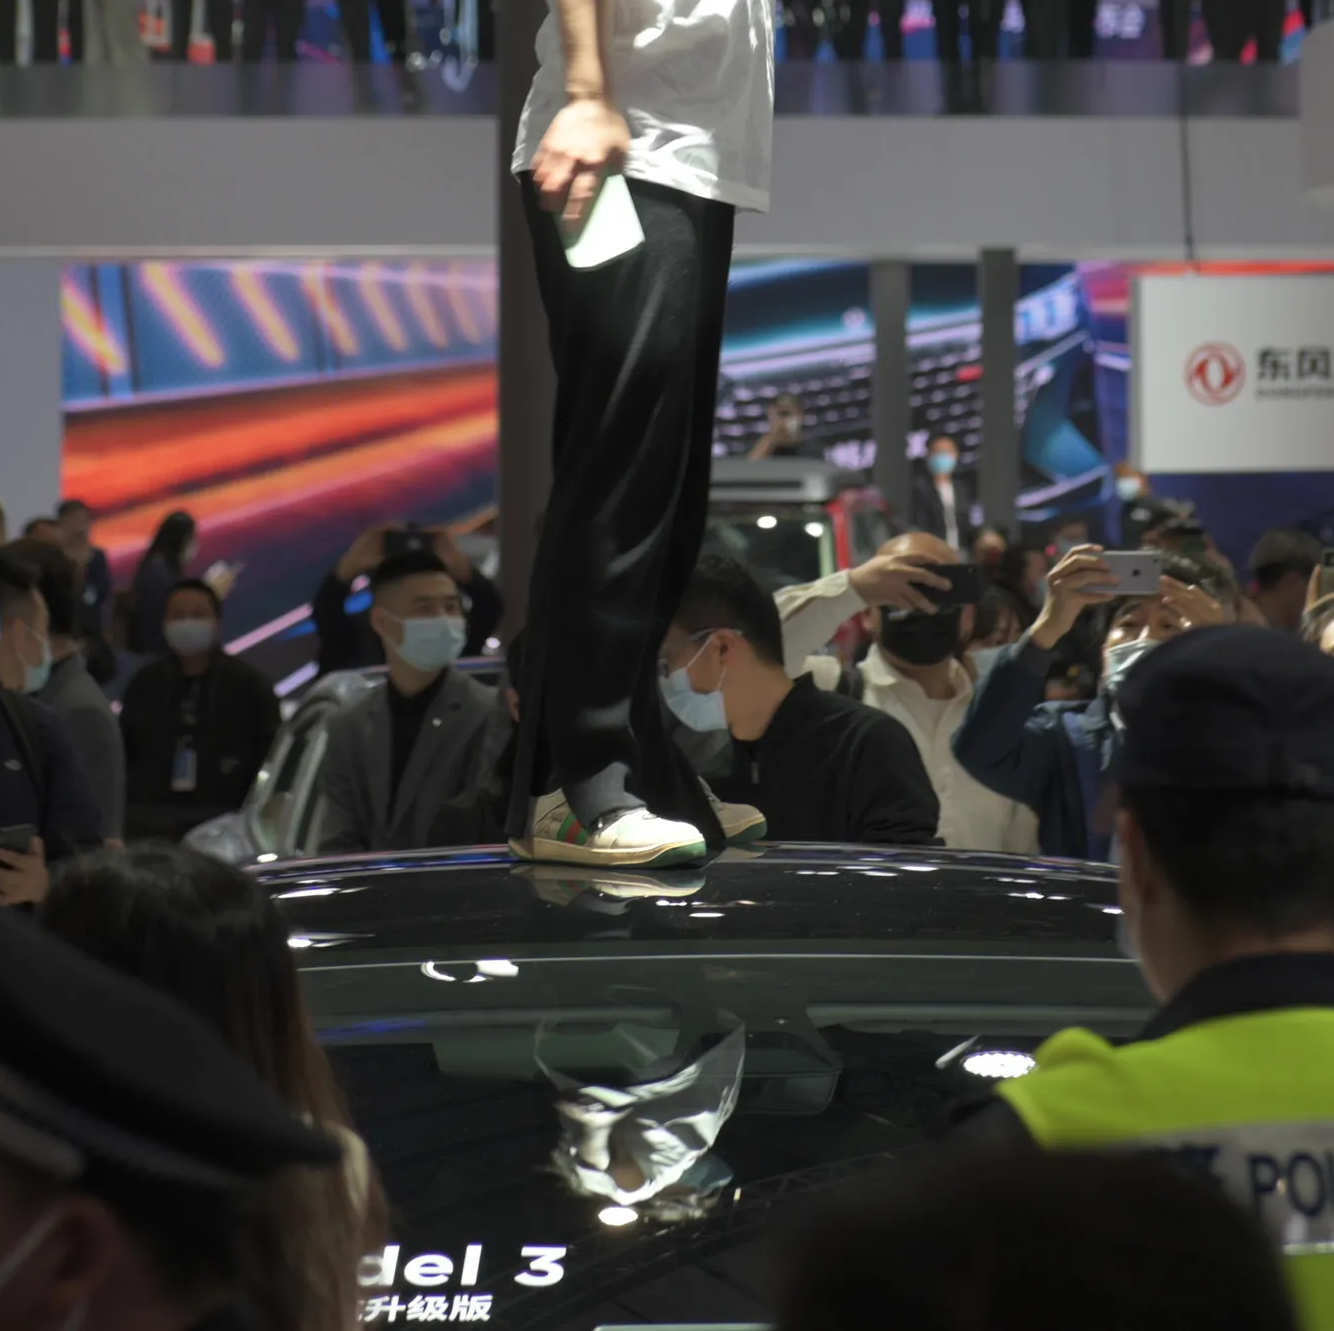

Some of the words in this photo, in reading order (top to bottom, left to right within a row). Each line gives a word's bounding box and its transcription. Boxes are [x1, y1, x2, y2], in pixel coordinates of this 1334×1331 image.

[513, 1243, 567, 1287] 3
[358, 1292, 494, 1323] 升级版
